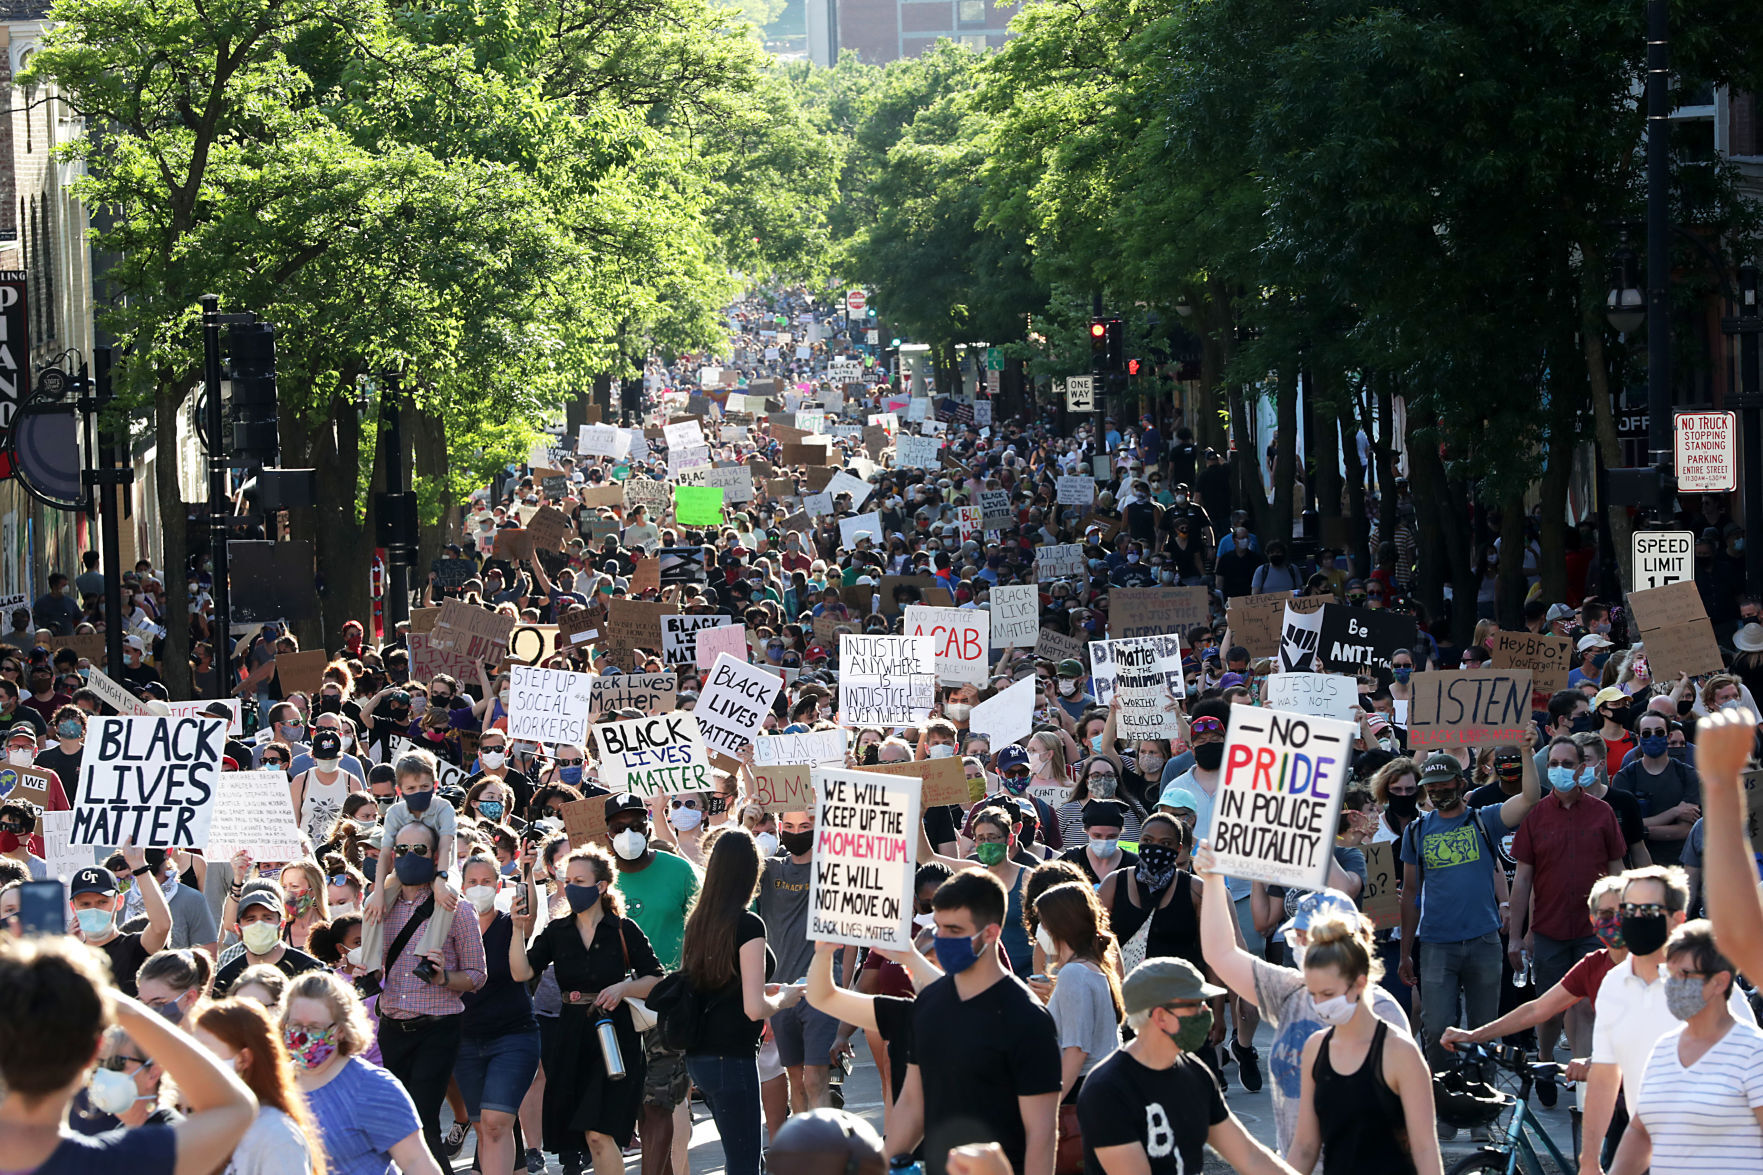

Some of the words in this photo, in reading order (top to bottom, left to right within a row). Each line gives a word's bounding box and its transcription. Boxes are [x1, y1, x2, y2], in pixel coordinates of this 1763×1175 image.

[1071, 381, 1090, 389] ONE
[1071, 390, 1090, 398] WAY
[1682, 418, 1694, 430] NO
[1698, 417, 1728, 429] TRUCK
[1684, 431, 1726, 440] STOPPING
[1685, 441, 1726, 450] STANDING
[1688, 455, 1724, 464] PARKING
[680, 472, 705, 483] BLAC
[1683, 466, 1704, 474] ENTIRE
[1706, 466, 1728, 474] STREET
[982, 491, 1004, 500] BLACK
[983, 501, 1006, 509] LIVES
[983, 511, 1010, 519] MATTER
[1637, 539, 1689, 554] SPEED
[1644, 558, 1684, 572] LIMIT
[995, 588, 1032, 605] BLACK
[911, 612, 927, 622] NO
[932, 611, 973, 622] JUSTICE
[1001, 601, 1036, 618] LIVES
[668, 618, 720, 632] BLACK
[994, 620, 1038, 639] MATTER
[1348, 618, 1368, 637] Be
[1041, 630, 1063, 644] BLACK
[845, 636, 918, 660] INJUSTICE
[1116, 646, 1156, 666] matter
[1500, 636, 1525, 655] Hey
[1526, 638, 1568, 660] Bro!
[850, 656, 922, 676] ANYWHERE
[514, 667, 550, 688] STEP
[556, 674, 576, 693] UP
[593, 675, 620, 688] ack
[627, 675, 676, 692] Lives
[714, 665, 770, 705] BLACK
[880, 674, 890, 687] IS
[1276, 676, 1337, 696] JESUS
[90, 671, 122, 702] ENOUGH
[124, 697, 133, 710] IS
[846, 687, 905, 707] INJUSTICE
[516, 692, 572, 716] SOCIAL
[589, 692, 660, 712] Matter
[708, 694, 758, 728] LIVES
[1278, 696, 1298, 706] WAS
[1309, 697, 1332, 709] NOT
[1411, 677, 1532, 726] LISTEN
[848, 707, 914, 723] EVERYWHERE
[510, 716, 584, 743] WORKERS!
[602, 718, 692, 754] BLACK
[696, 716, 750, 752] MATTER
[1268, 715, 1309, 748] NO
[1411, 729, 1455, 745] BLACK
[98, 718, 222, 762] BLACK
[756, 734, 839, 761] BLACK
[622, 744, 692, 768] LIVES
[1224, 744, 1336, 799] PRIDE
[1425, 764, 1447, 772] MATH
[25, 776, 45, 790] WE
[84, 762, 214, 806] LIVES
[627, 765, 710, 797] MATTER
[756, 775, 806, 806] BLM
[824, 779, 847, 802] WE
[854, 782, 890, 806] WILL
[820, 805, 856, 829] KEEP
[860, 810, 876, 831] UP
[880, 812, 904, 834] THE
[1220, 790, 1244, 819] IN
[1250, 793, 1326, 833] POLICE
[70, 805, 196, 846] MATTER
[1214, 821, 1320, 868] BRUTALITY.
[817, 862, 840, 886] WE
[847, 866, 884, 890] WILL
[814, 888, 837, 912] NOT
[840, 892, 879, 917] MOVE
[882, 896, 902, 920] ON.
[813, 916, 838, 934] BLACK
[841, 920, 862, 938] LIVES
[864, 924, 896, 942] MATTER
